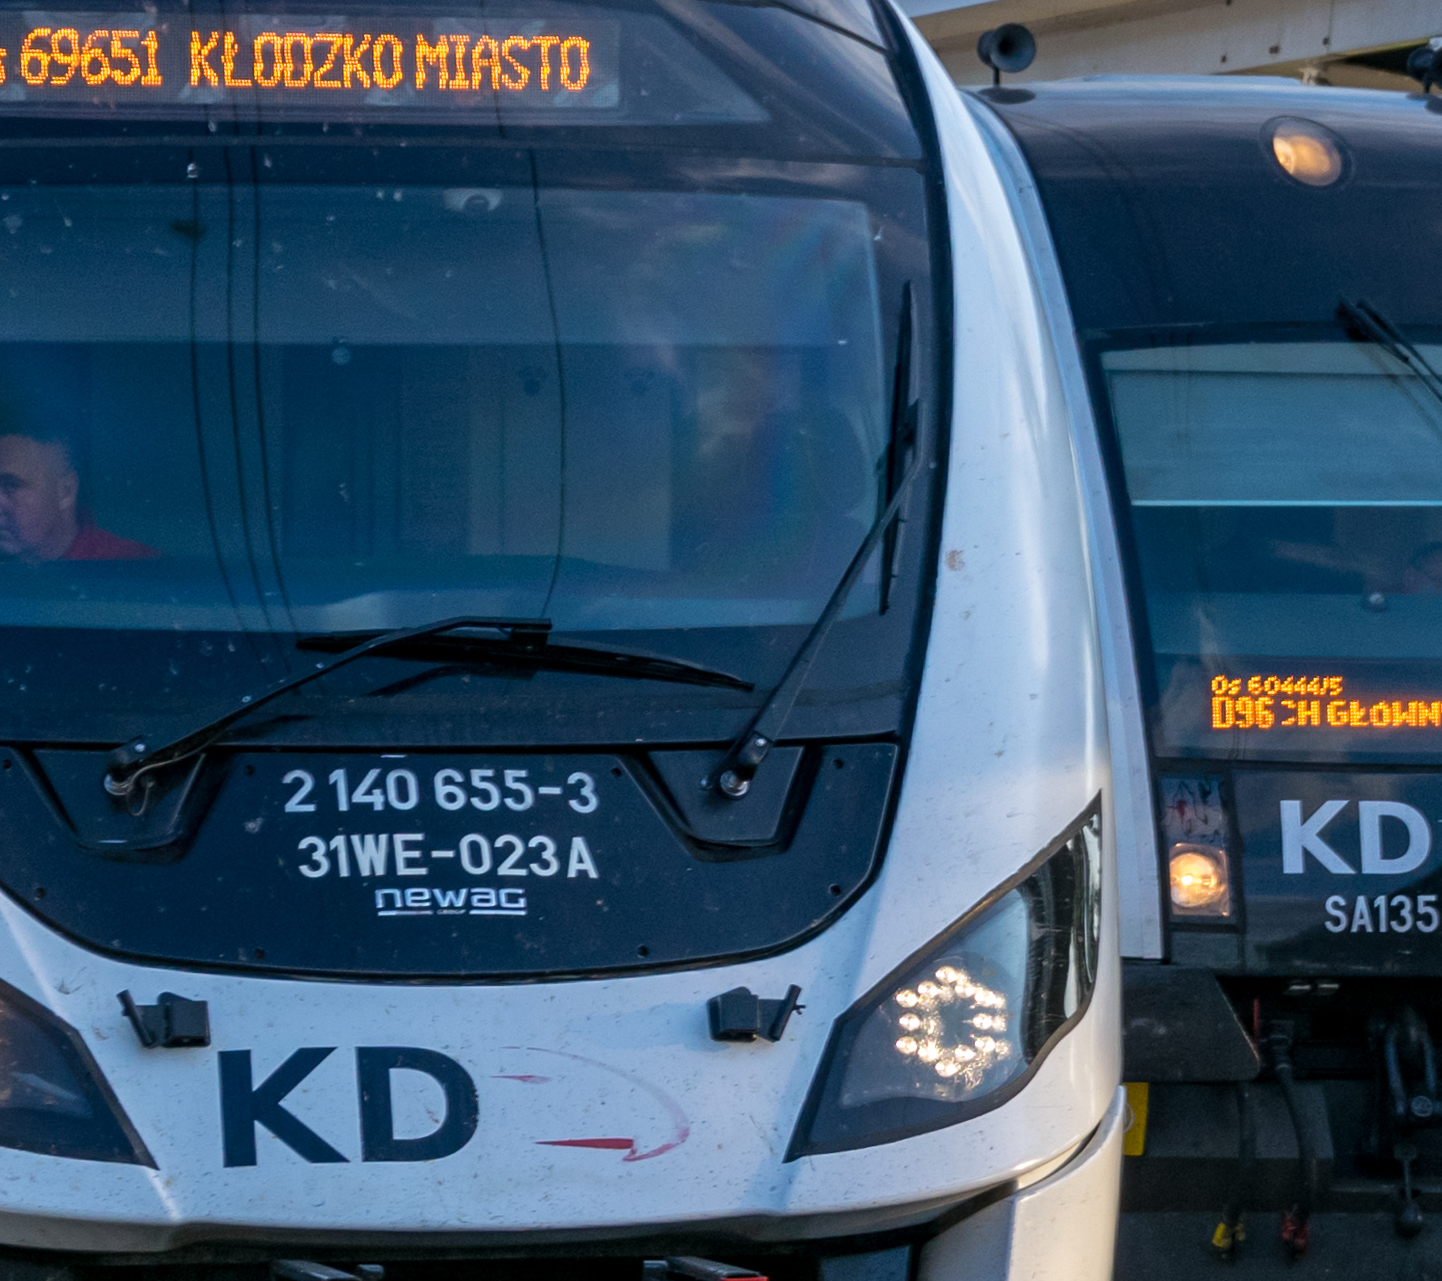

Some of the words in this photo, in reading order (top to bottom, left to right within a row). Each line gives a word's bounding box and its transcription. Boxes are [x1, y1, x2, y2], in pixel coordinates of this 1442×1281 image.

[20, 28, 163, 86] 69651
[190, 30, 403, 89] KŁODZKO
[415, 32, 591, 92] MIASTO
[1211, 696, 1275, 729] D96
[282, 769, 317, 813] 2
[328, 768, 420, 811] 140
[433, 768, 600, 814] 655-3
[1279, 799, 1432, 875] KD
[217, 1045, 480, 1169] KD
